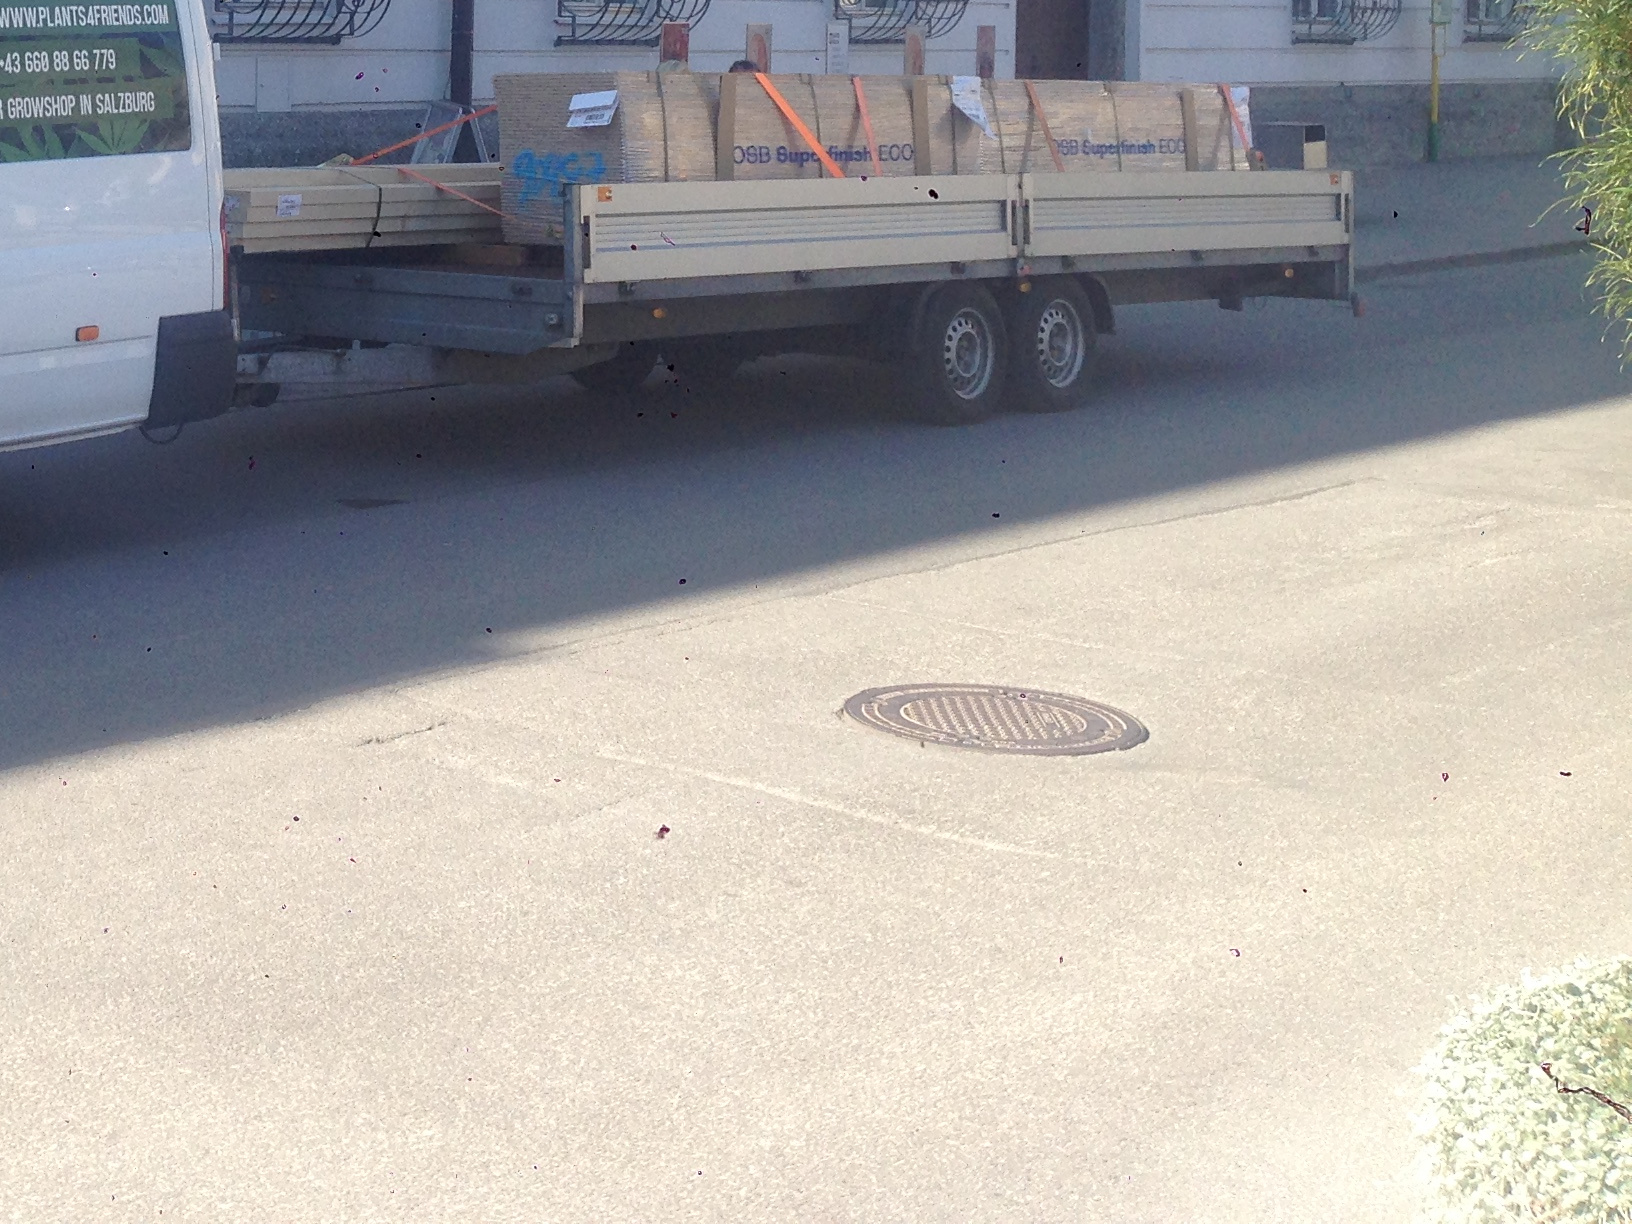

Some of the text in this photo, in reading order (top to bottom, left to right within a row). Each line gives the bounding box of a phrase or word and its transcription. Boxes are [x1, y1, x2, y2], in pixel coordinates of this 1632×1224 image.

[24, 51, 49, 72] 660
[53, 50, 69, 71] 88
[73, 50, 89, 70] 66
[92, 49, 116, 70] 779
[7, 95, 76, 119] GROWSHOP
[79, 94, 92, 116] IN
[96, 91, 155, 114] SALZBURG
[733, 143, 914, 167] OSB Supefinish ECO
